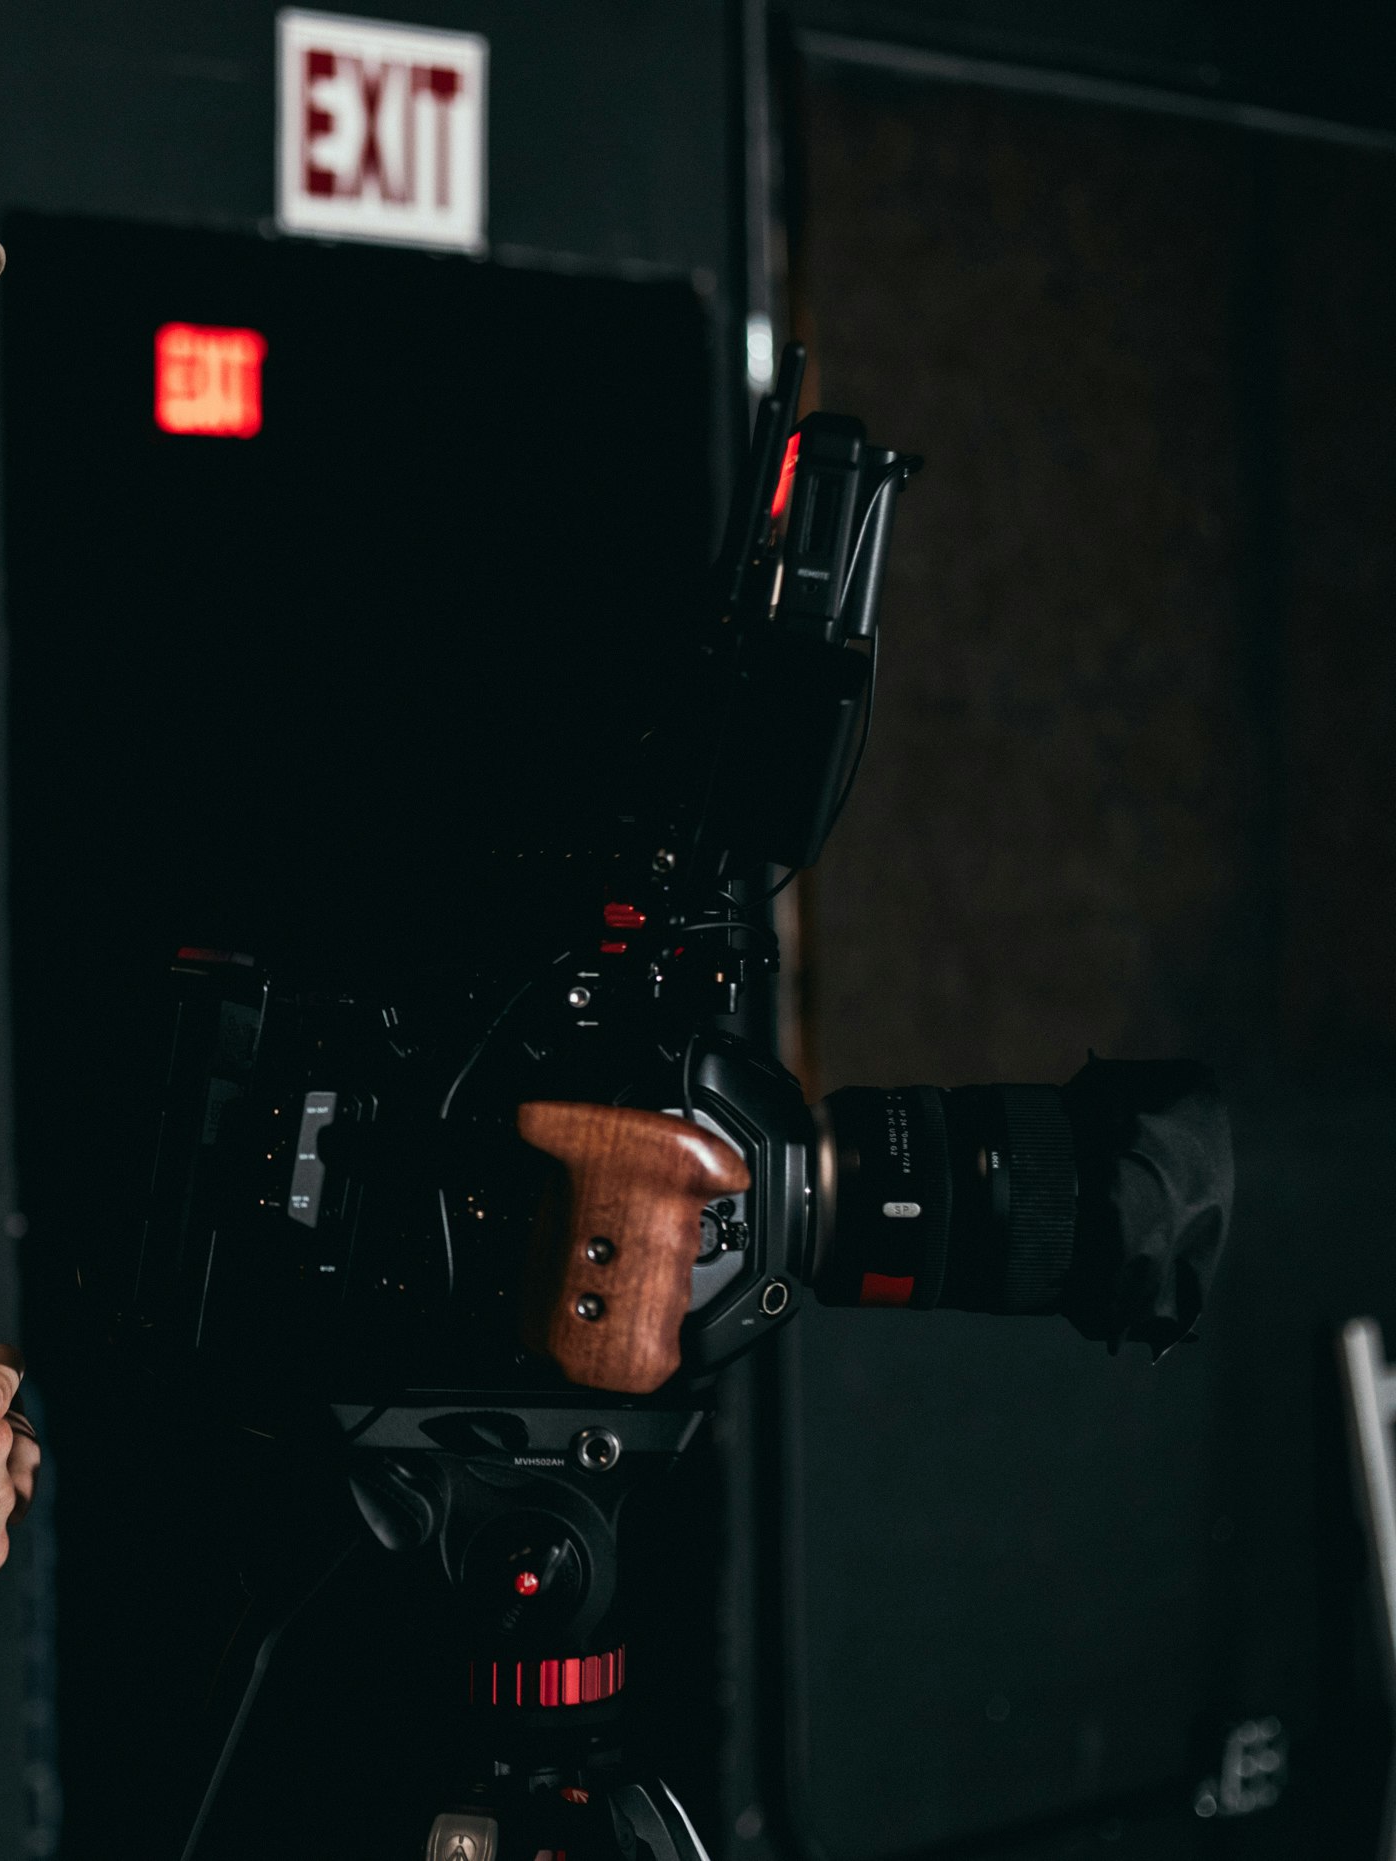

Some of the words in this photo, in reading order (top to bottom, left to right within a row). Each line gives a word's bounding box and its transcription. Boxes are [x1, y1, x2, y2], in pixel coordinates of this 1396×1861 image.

[303, 50, 461, 211] EXIT
[991, 1151, 999, 1169] LOCK
[894, 1205, 909, 1215] SP
[514, 1457, 565, 1467] MVH502AH
